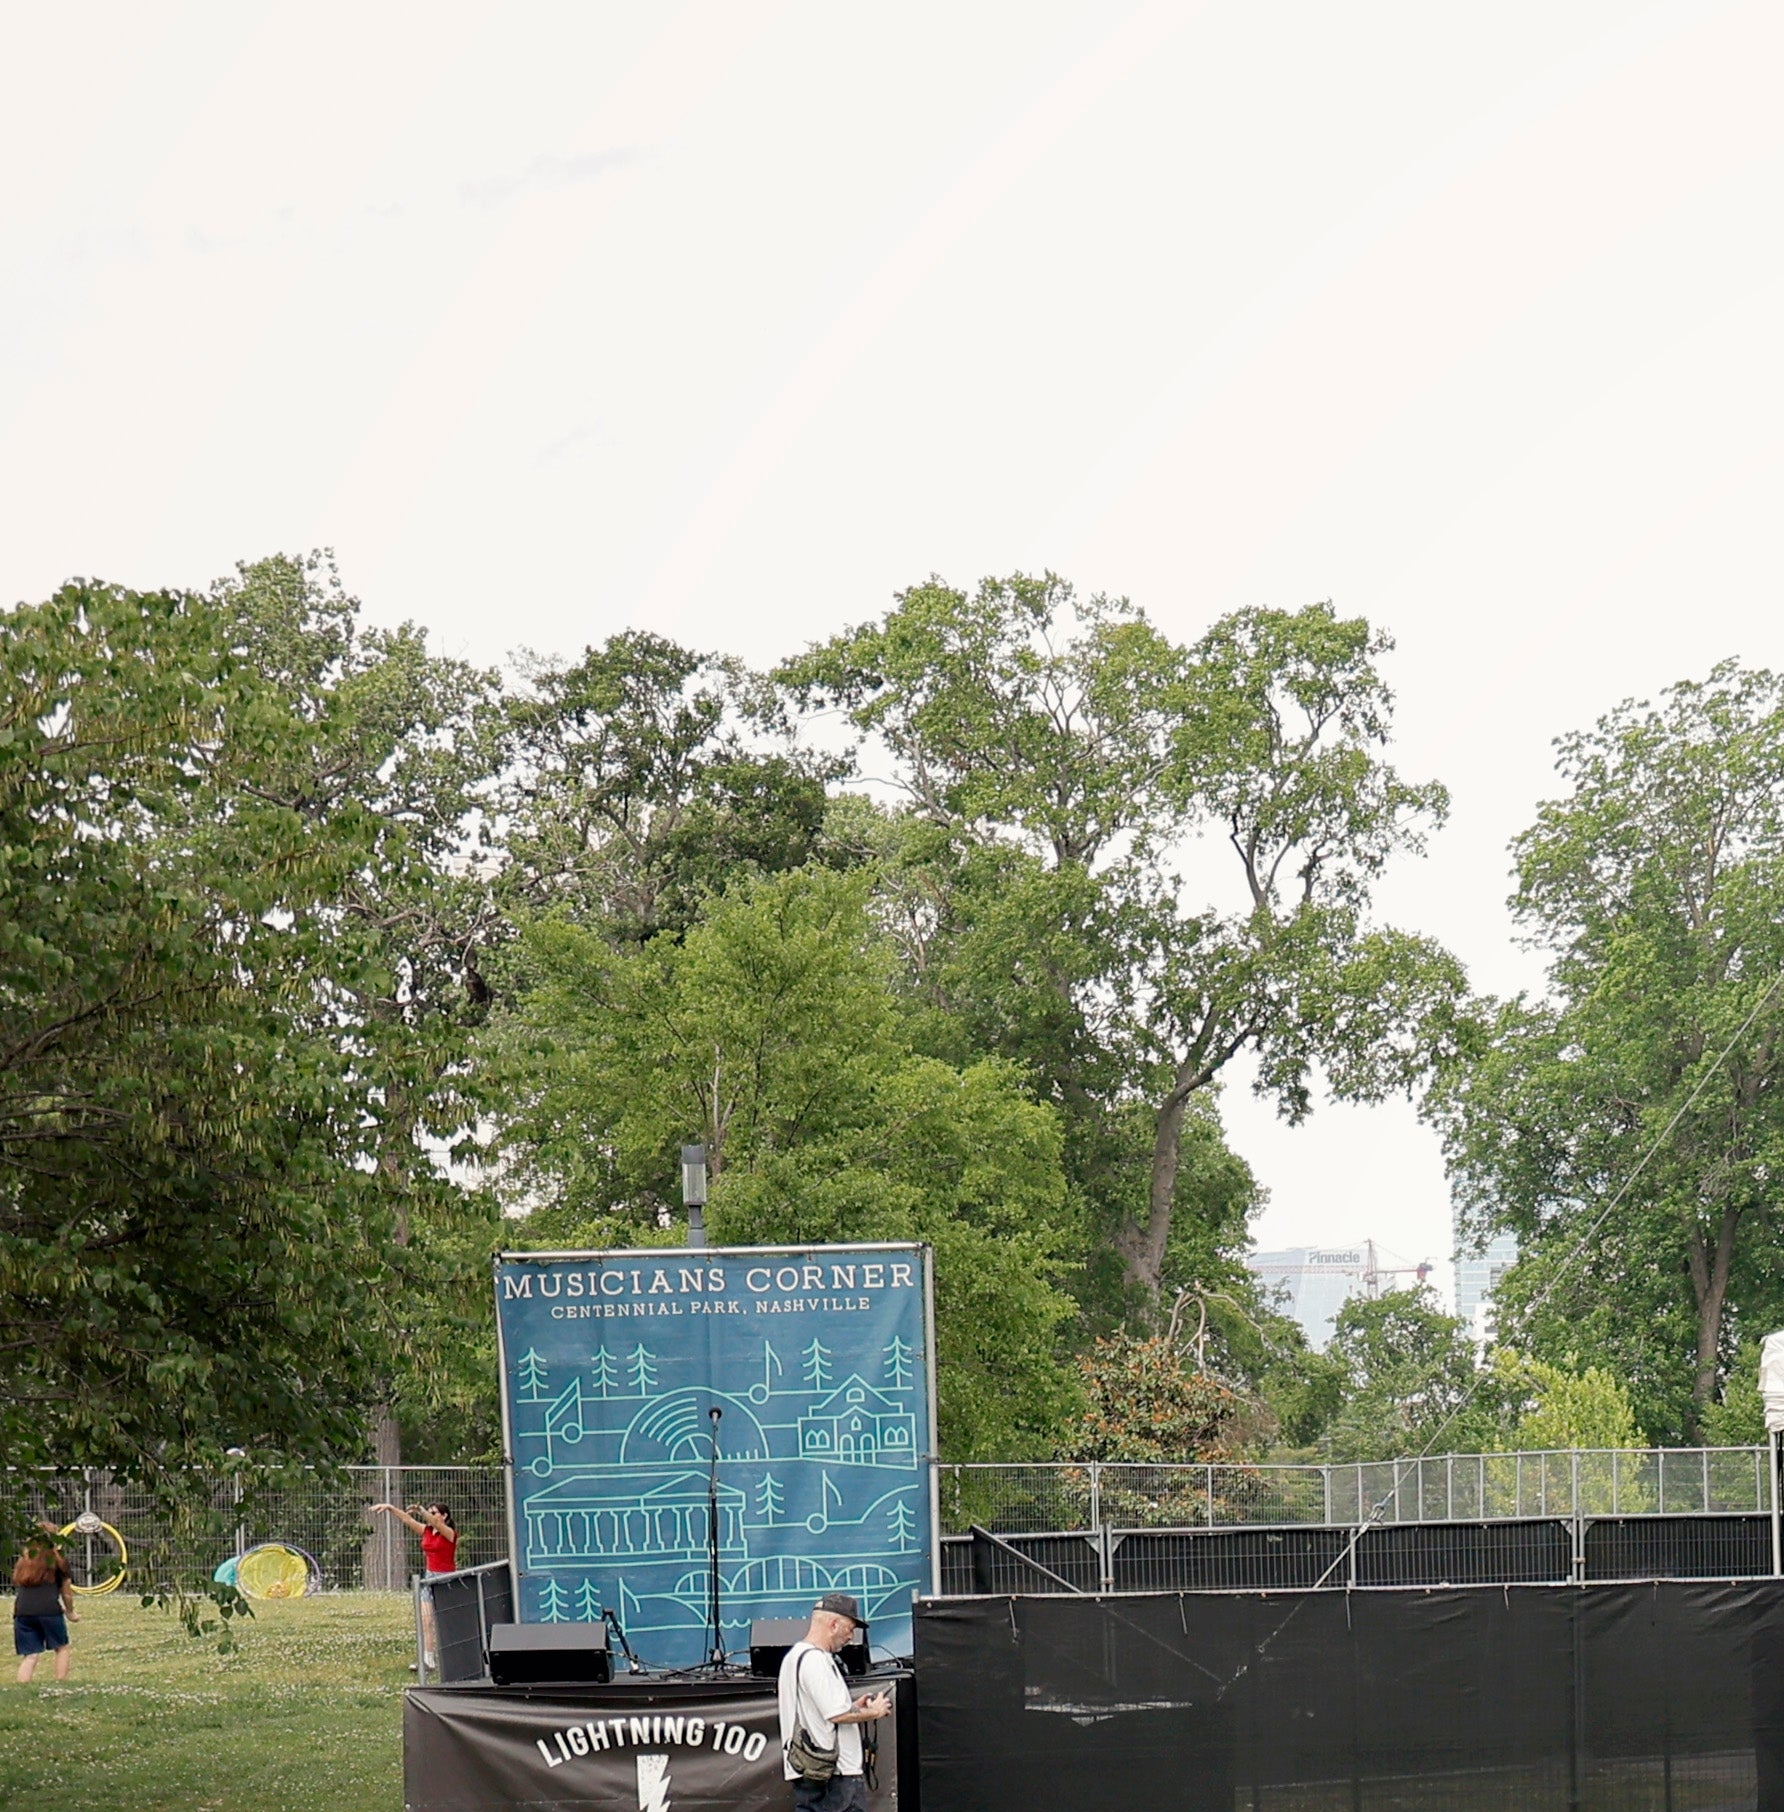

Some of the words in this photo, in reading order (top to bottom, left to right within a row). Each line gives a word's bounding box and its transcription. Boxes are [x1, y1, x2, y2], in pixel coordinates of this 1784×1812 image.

[503, 1267, 726, 1299] MUSICIANS
[746, 1263, 914, 1292] CORNER
[551, 1302, 683, 1319] CENTENNIAL
[690, 1300, 748, 1316] PARK,
[756, 1297, 871, 1314] NASHVILLE
[536, 1716, 706, 1769] LIGHTNING
[712, 1721, 768, 1762] 100
